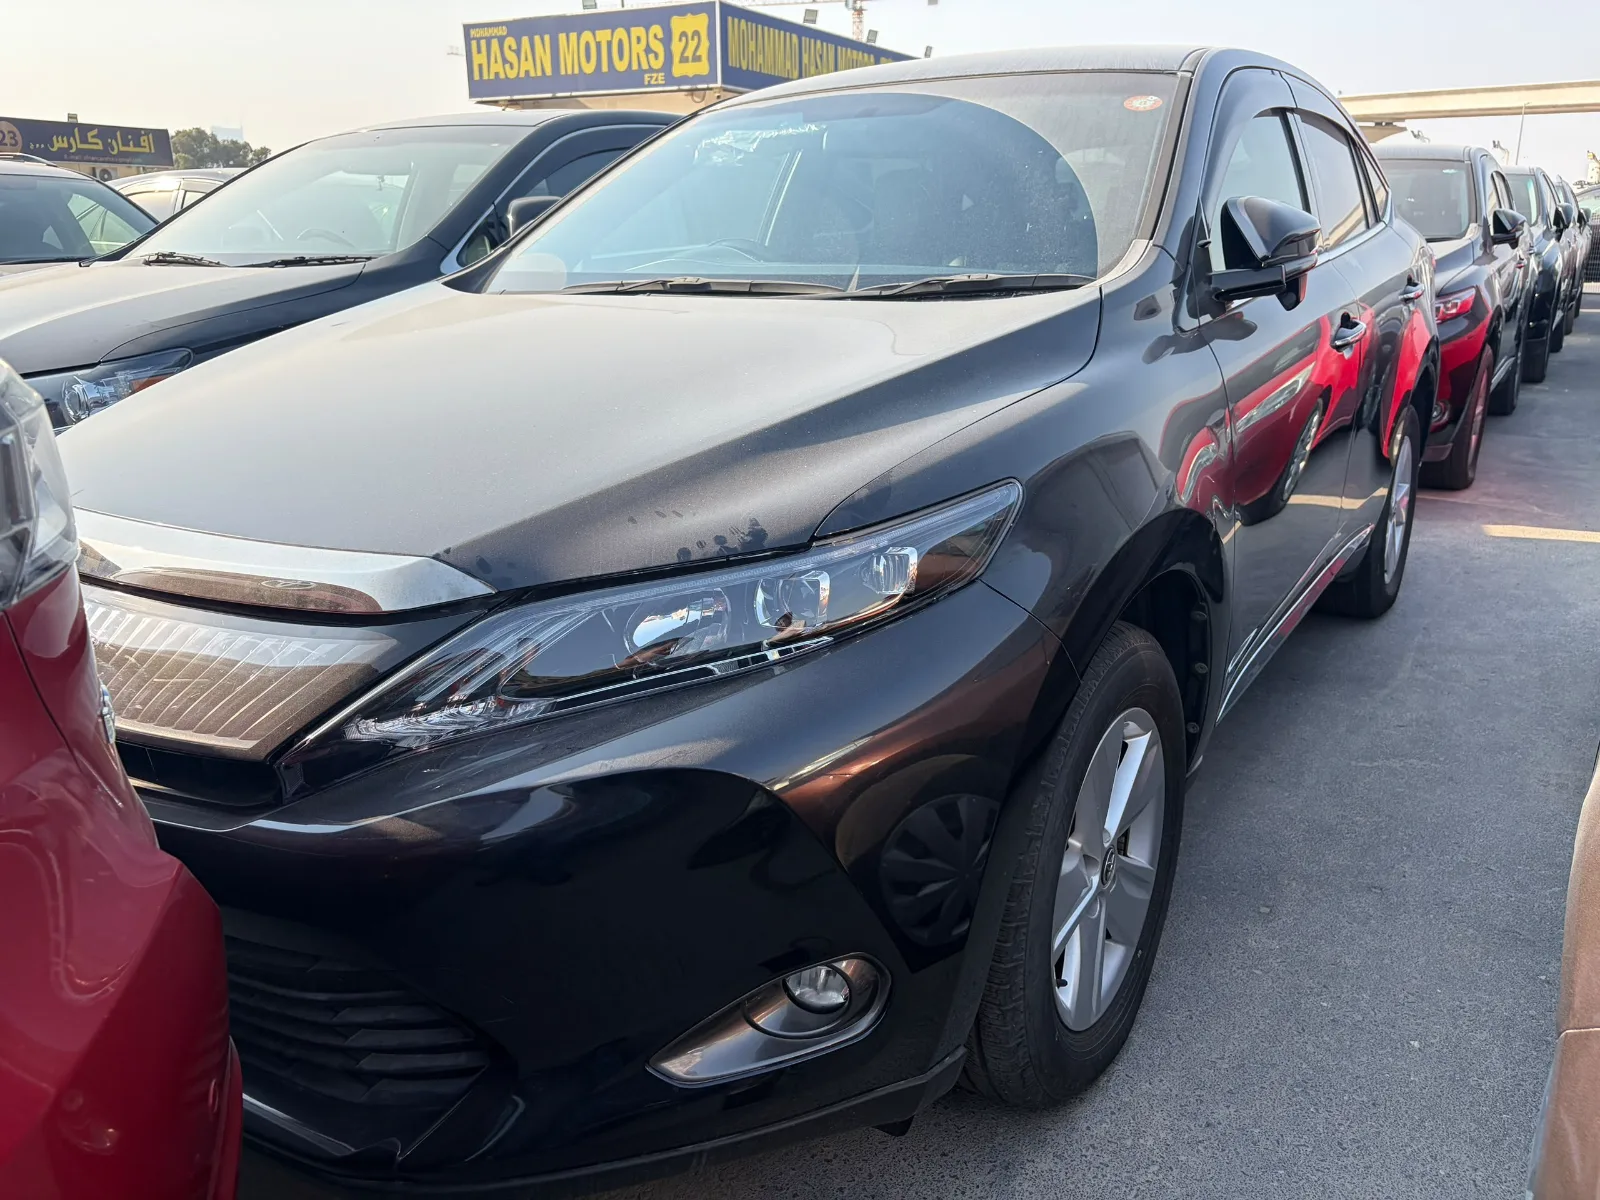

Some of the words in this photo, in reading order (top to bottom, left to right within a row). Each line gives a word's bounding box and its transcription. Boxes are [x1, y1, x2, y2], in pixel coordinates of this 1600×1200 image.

[470, 25, 507, 39] MOHAMMAD
[678, 29, 702, 64] 22
[727, 16, 799, 80] MOHAMMAD
[802, 36, 835, 78] HASAN
[471, 34, 552, 80] HASAN
[558, 24, 665, 76] MOTORS
[644, 72, 666, 85] FZE
